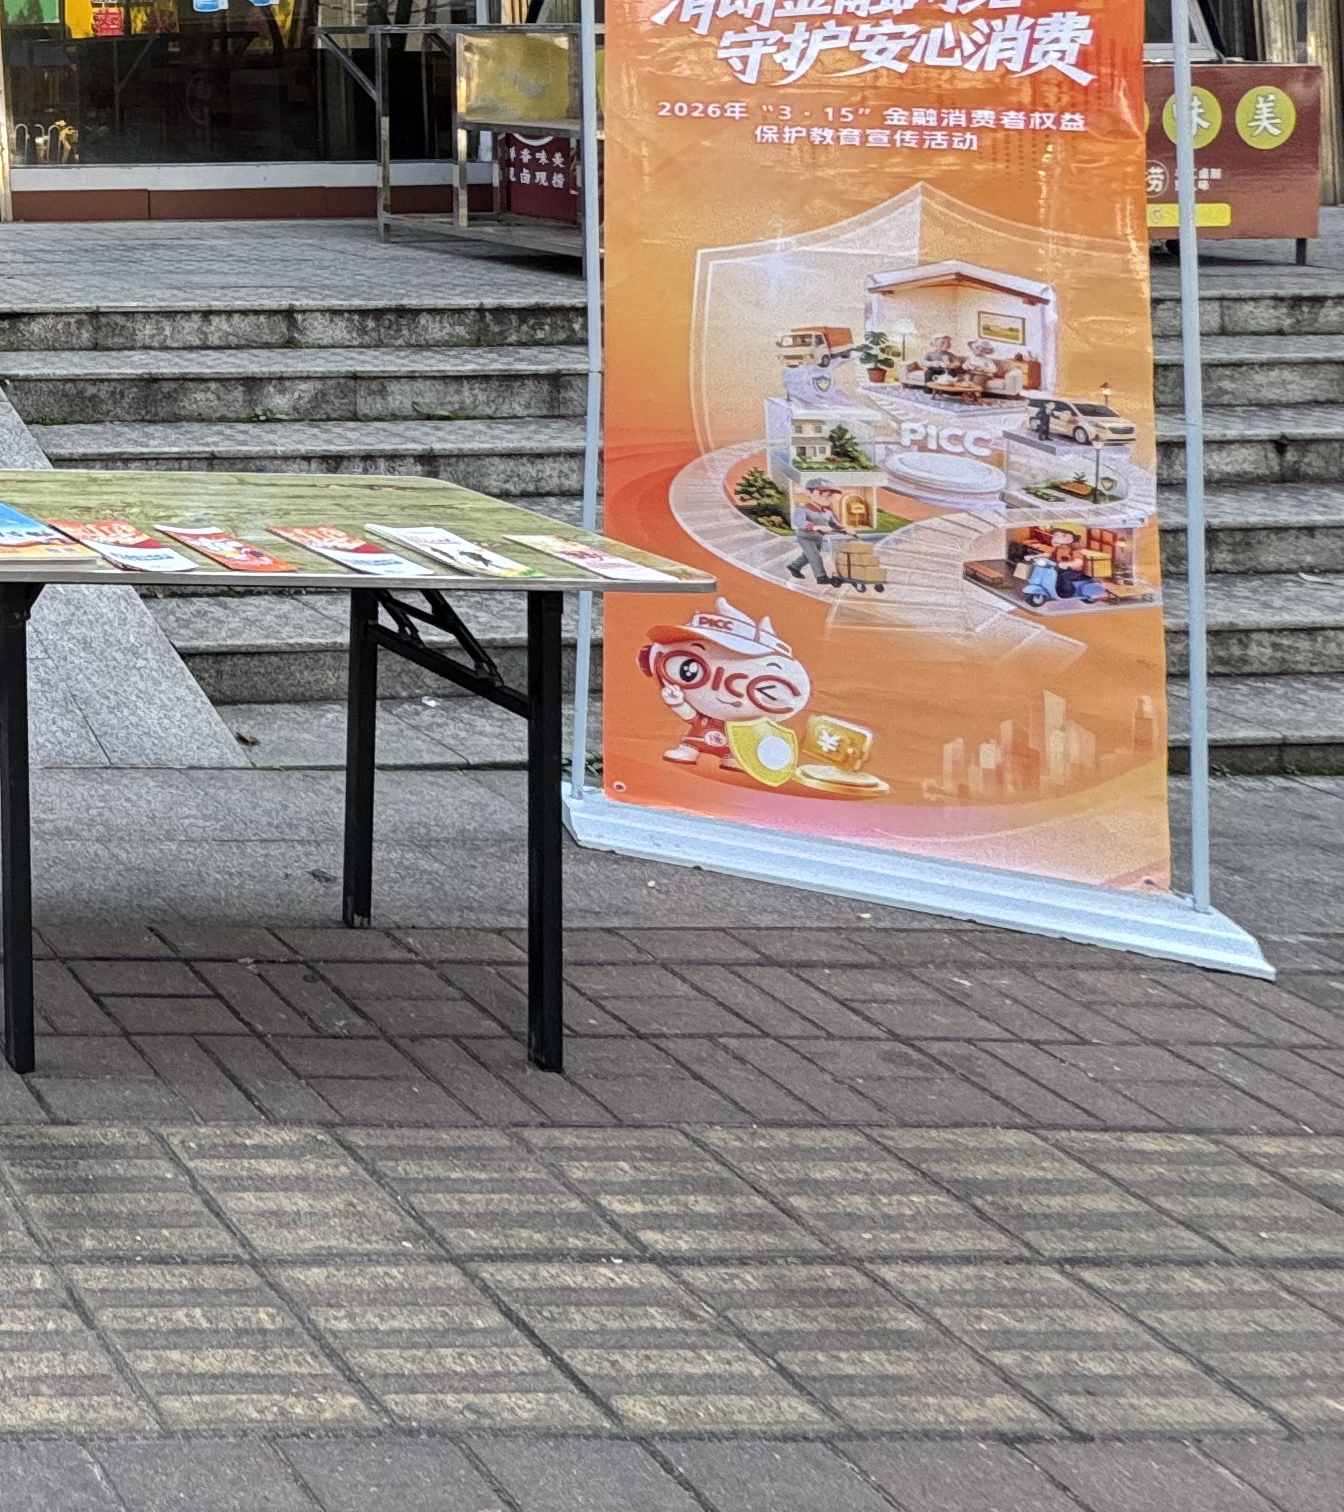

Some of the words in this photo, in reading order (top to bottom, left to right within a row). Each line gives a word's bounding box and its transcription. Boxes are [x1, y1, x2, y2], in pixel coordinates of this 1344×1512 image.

[716, 10, 1099, 87] 守护安心消费
[656, 101, 749, 120] 2026年
[882, 106, 1087, 132] 金融消费者权益
[753, 124, 979, 152] 保护教育宣传活动
[900, 419, 998, 457] PICC
[698, 615, 735, 632] PICC
